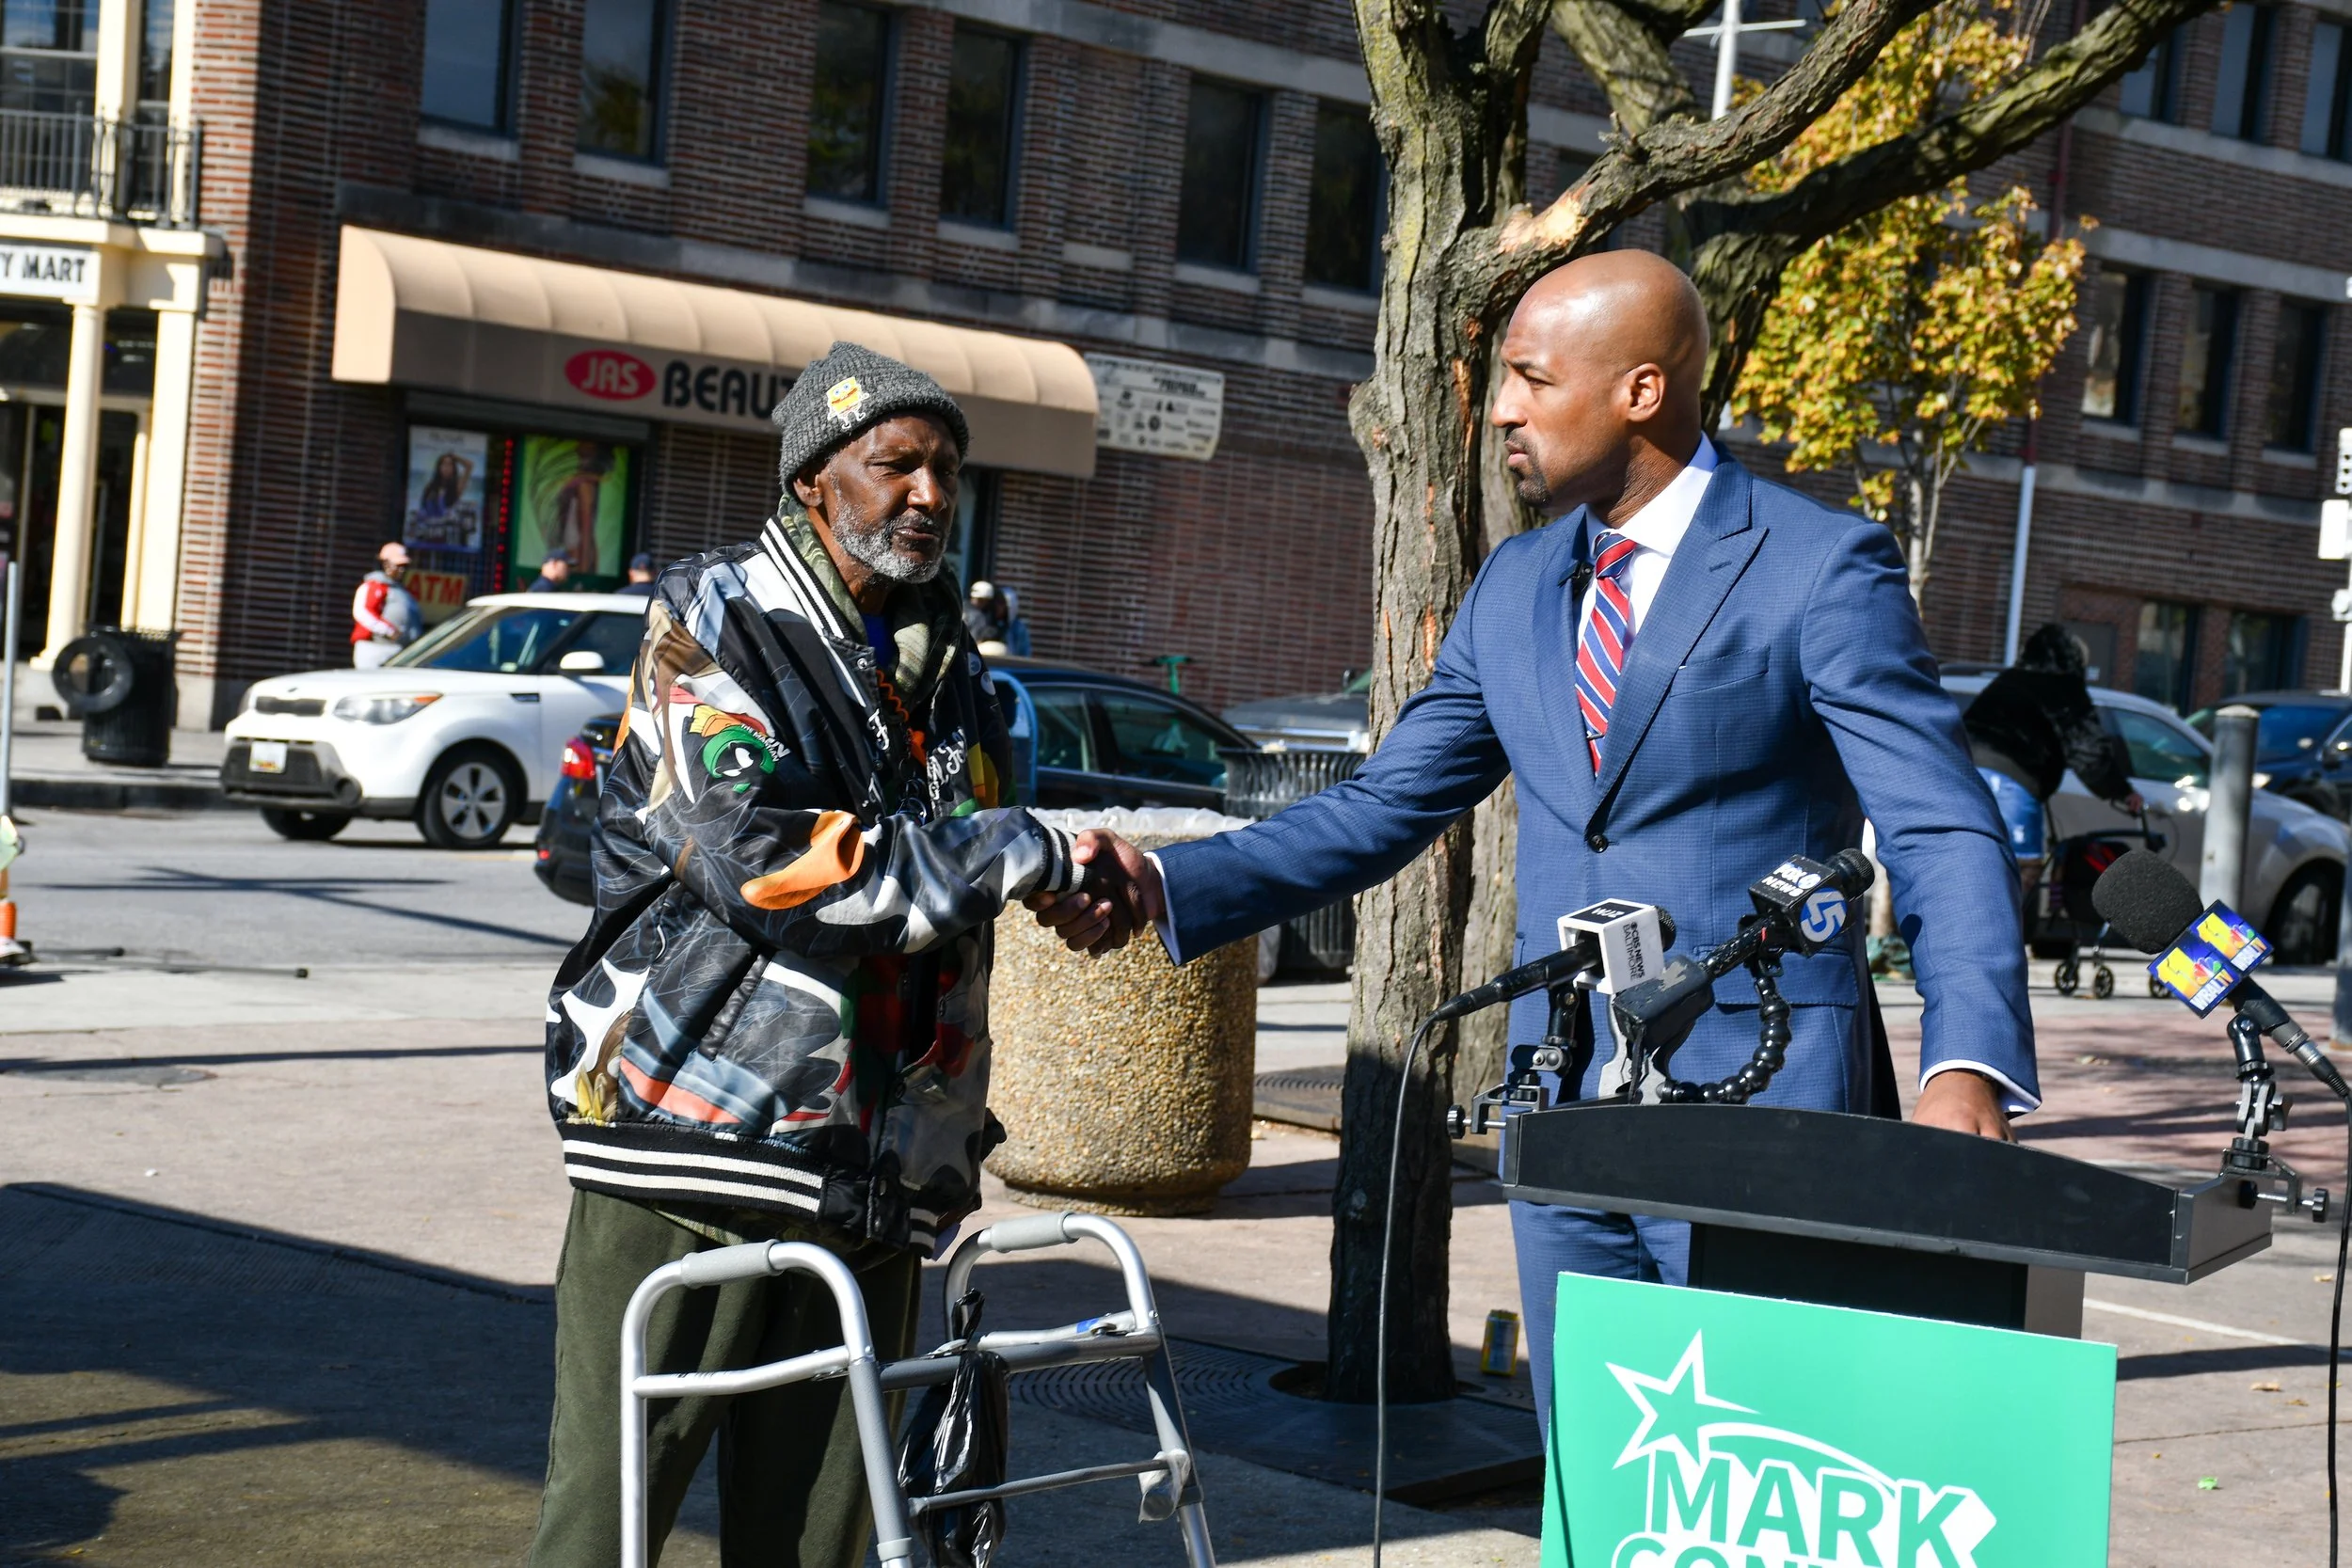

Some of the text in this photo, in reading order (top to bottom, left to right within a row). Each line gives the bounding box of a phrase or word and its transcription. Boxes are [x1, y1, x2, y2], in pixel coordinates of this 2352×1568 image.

[23, 255, 86, 282] MART
[580, 357, 640, 395] JAS
[406, 574, 463, 607] ATM
[1623, 924, 1638, 982] BALTIMORE
[1631, 929, 1645, 978] CBS NEWS
[1646, 1449, 1972, 1568] MARK
